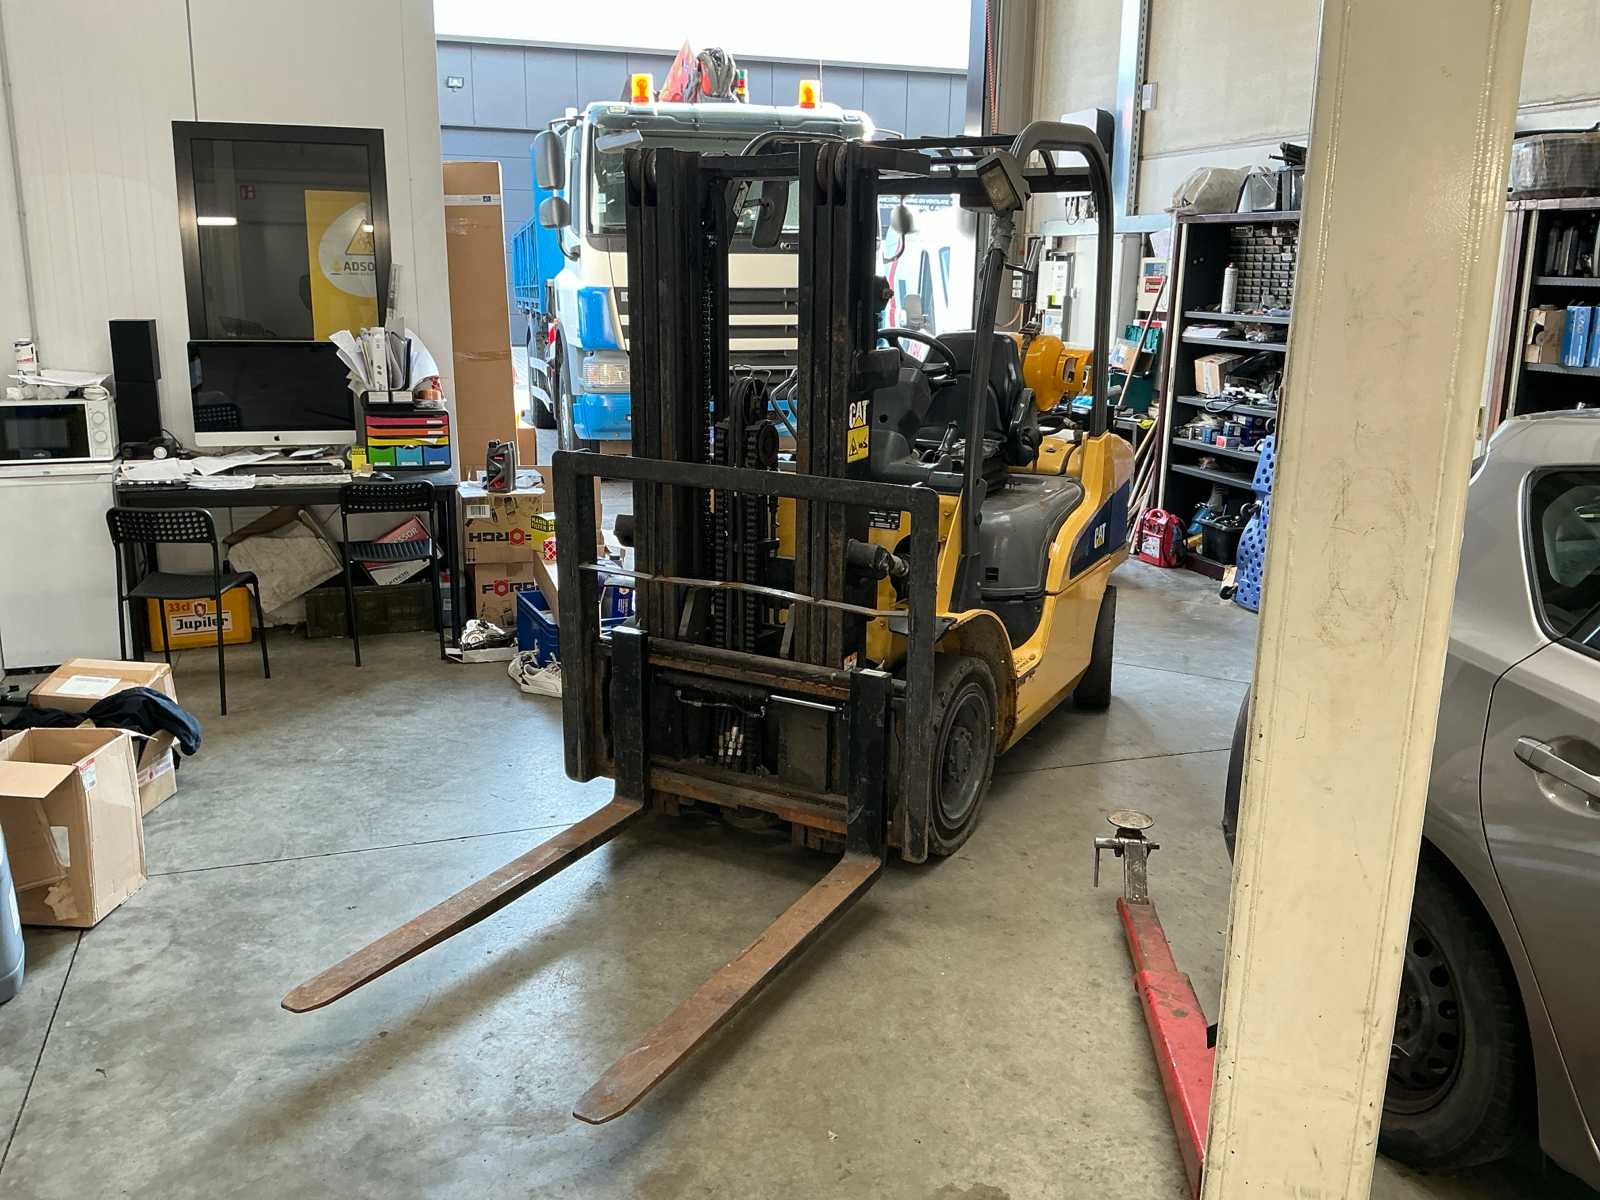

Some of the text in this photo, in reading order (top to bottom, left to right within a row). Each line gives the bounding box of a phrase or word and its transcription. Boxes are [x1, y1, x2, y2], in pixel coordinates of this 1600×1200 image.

[848, 399, 870, 429] CAT
[1094, 522, 1106, 549] CAT
[168, 603, 180, 612] 33
